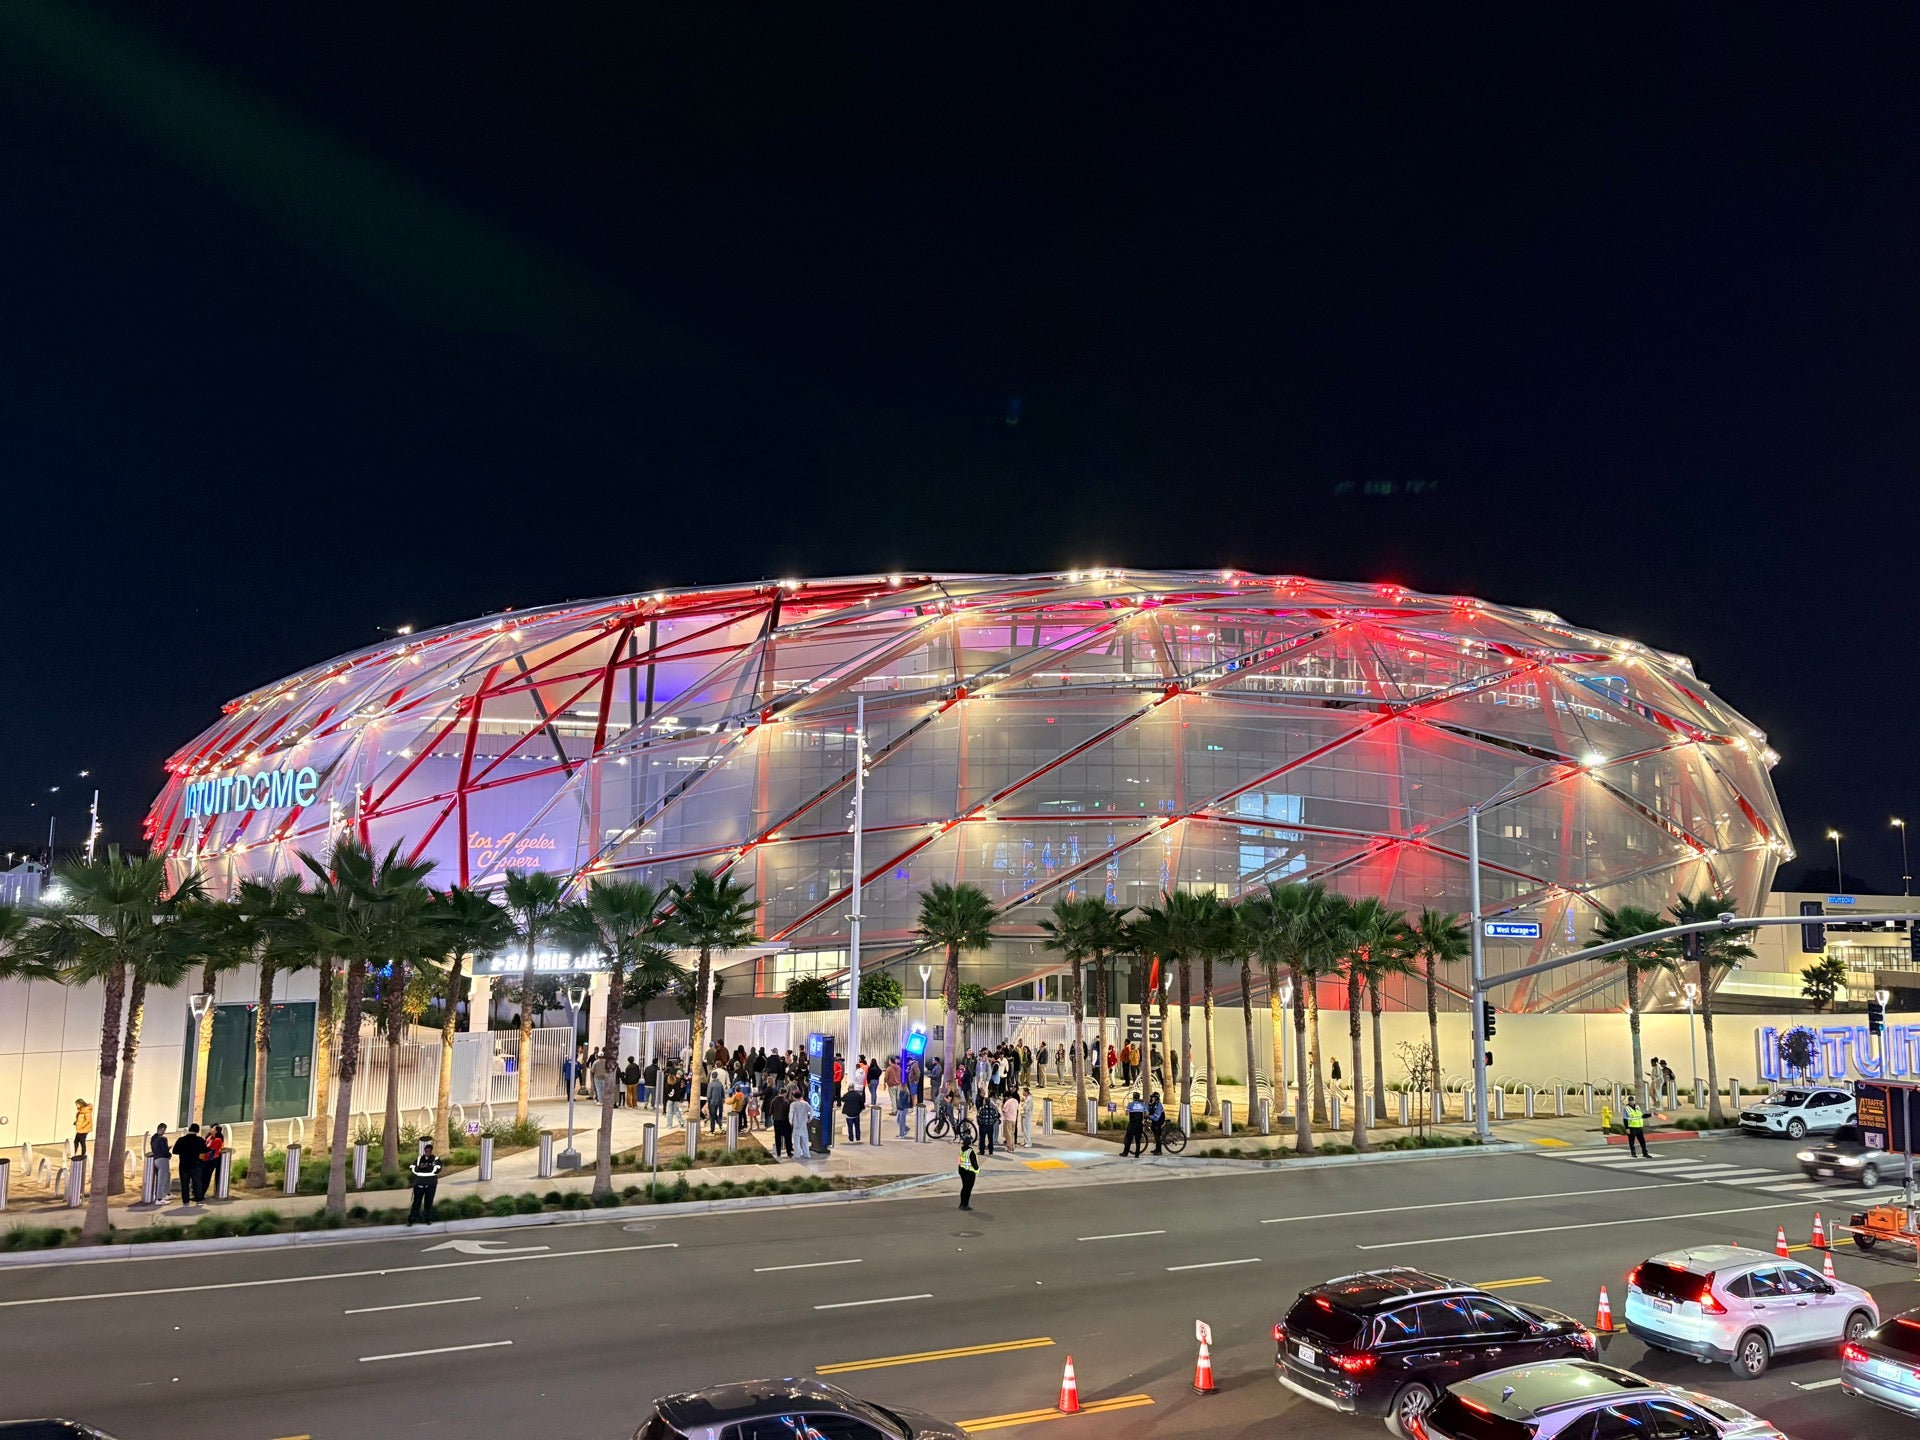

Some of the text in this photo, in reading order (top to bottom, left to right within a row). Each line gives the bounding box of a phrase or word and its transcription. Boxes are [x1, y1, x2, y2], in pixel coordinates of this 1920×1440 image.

[468, 831, 556, 854] Los Ageles
[477, 850, 541, 872] Clppers
[1496, 926, 1530, 936] West Garage
